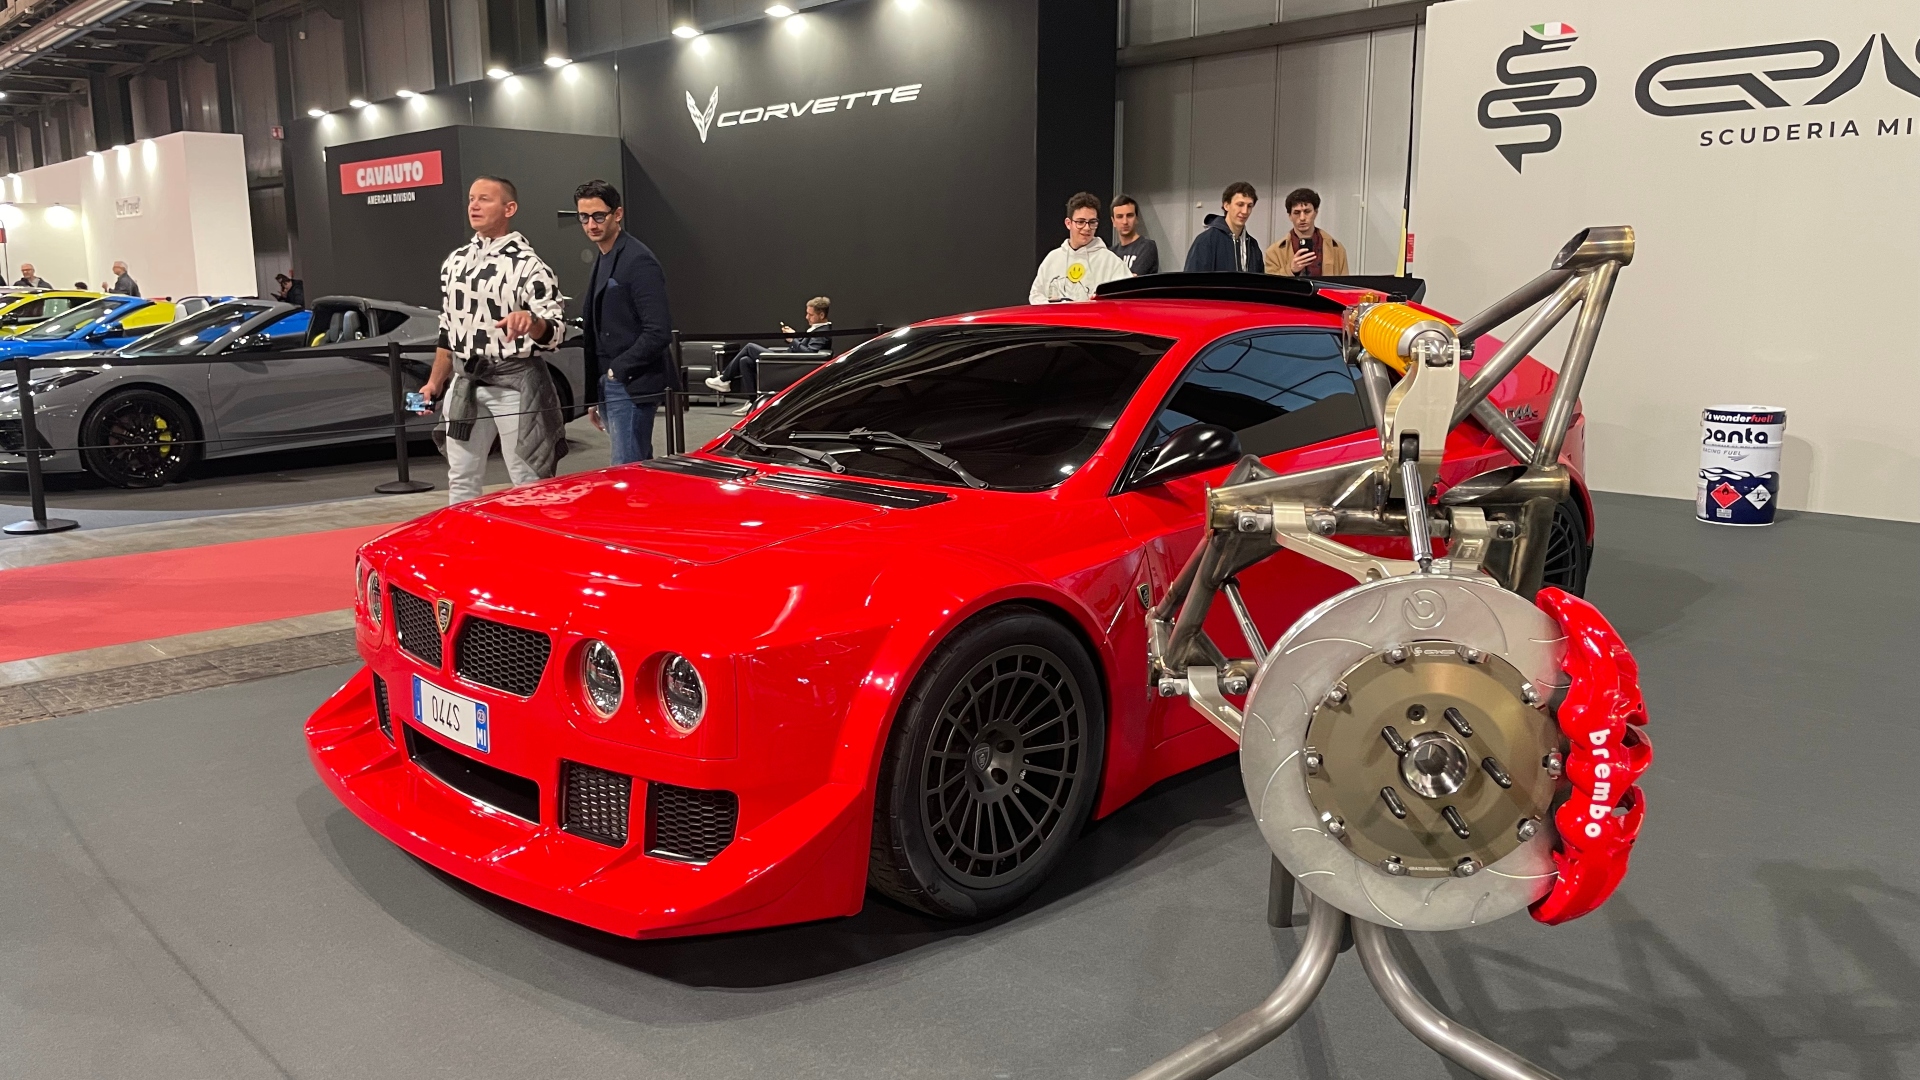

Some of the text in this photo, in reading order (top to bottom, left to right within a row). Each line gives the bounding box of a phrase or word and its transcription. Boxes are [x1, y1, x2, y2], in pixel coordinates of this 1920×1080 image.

[716, 83, 922, 128] CORVETTE
[1700, 119, 1860, 147] SCUDERIA
[356, 160, 424, 188] CAVAUTO
[367, 191, 416, 205] AMERICAN DIVISION
[1713, 413, 1774, 423] wonderfuel!
[476, 727, 487, 747] MI
[1585, 728, 1612, 838] brembo
